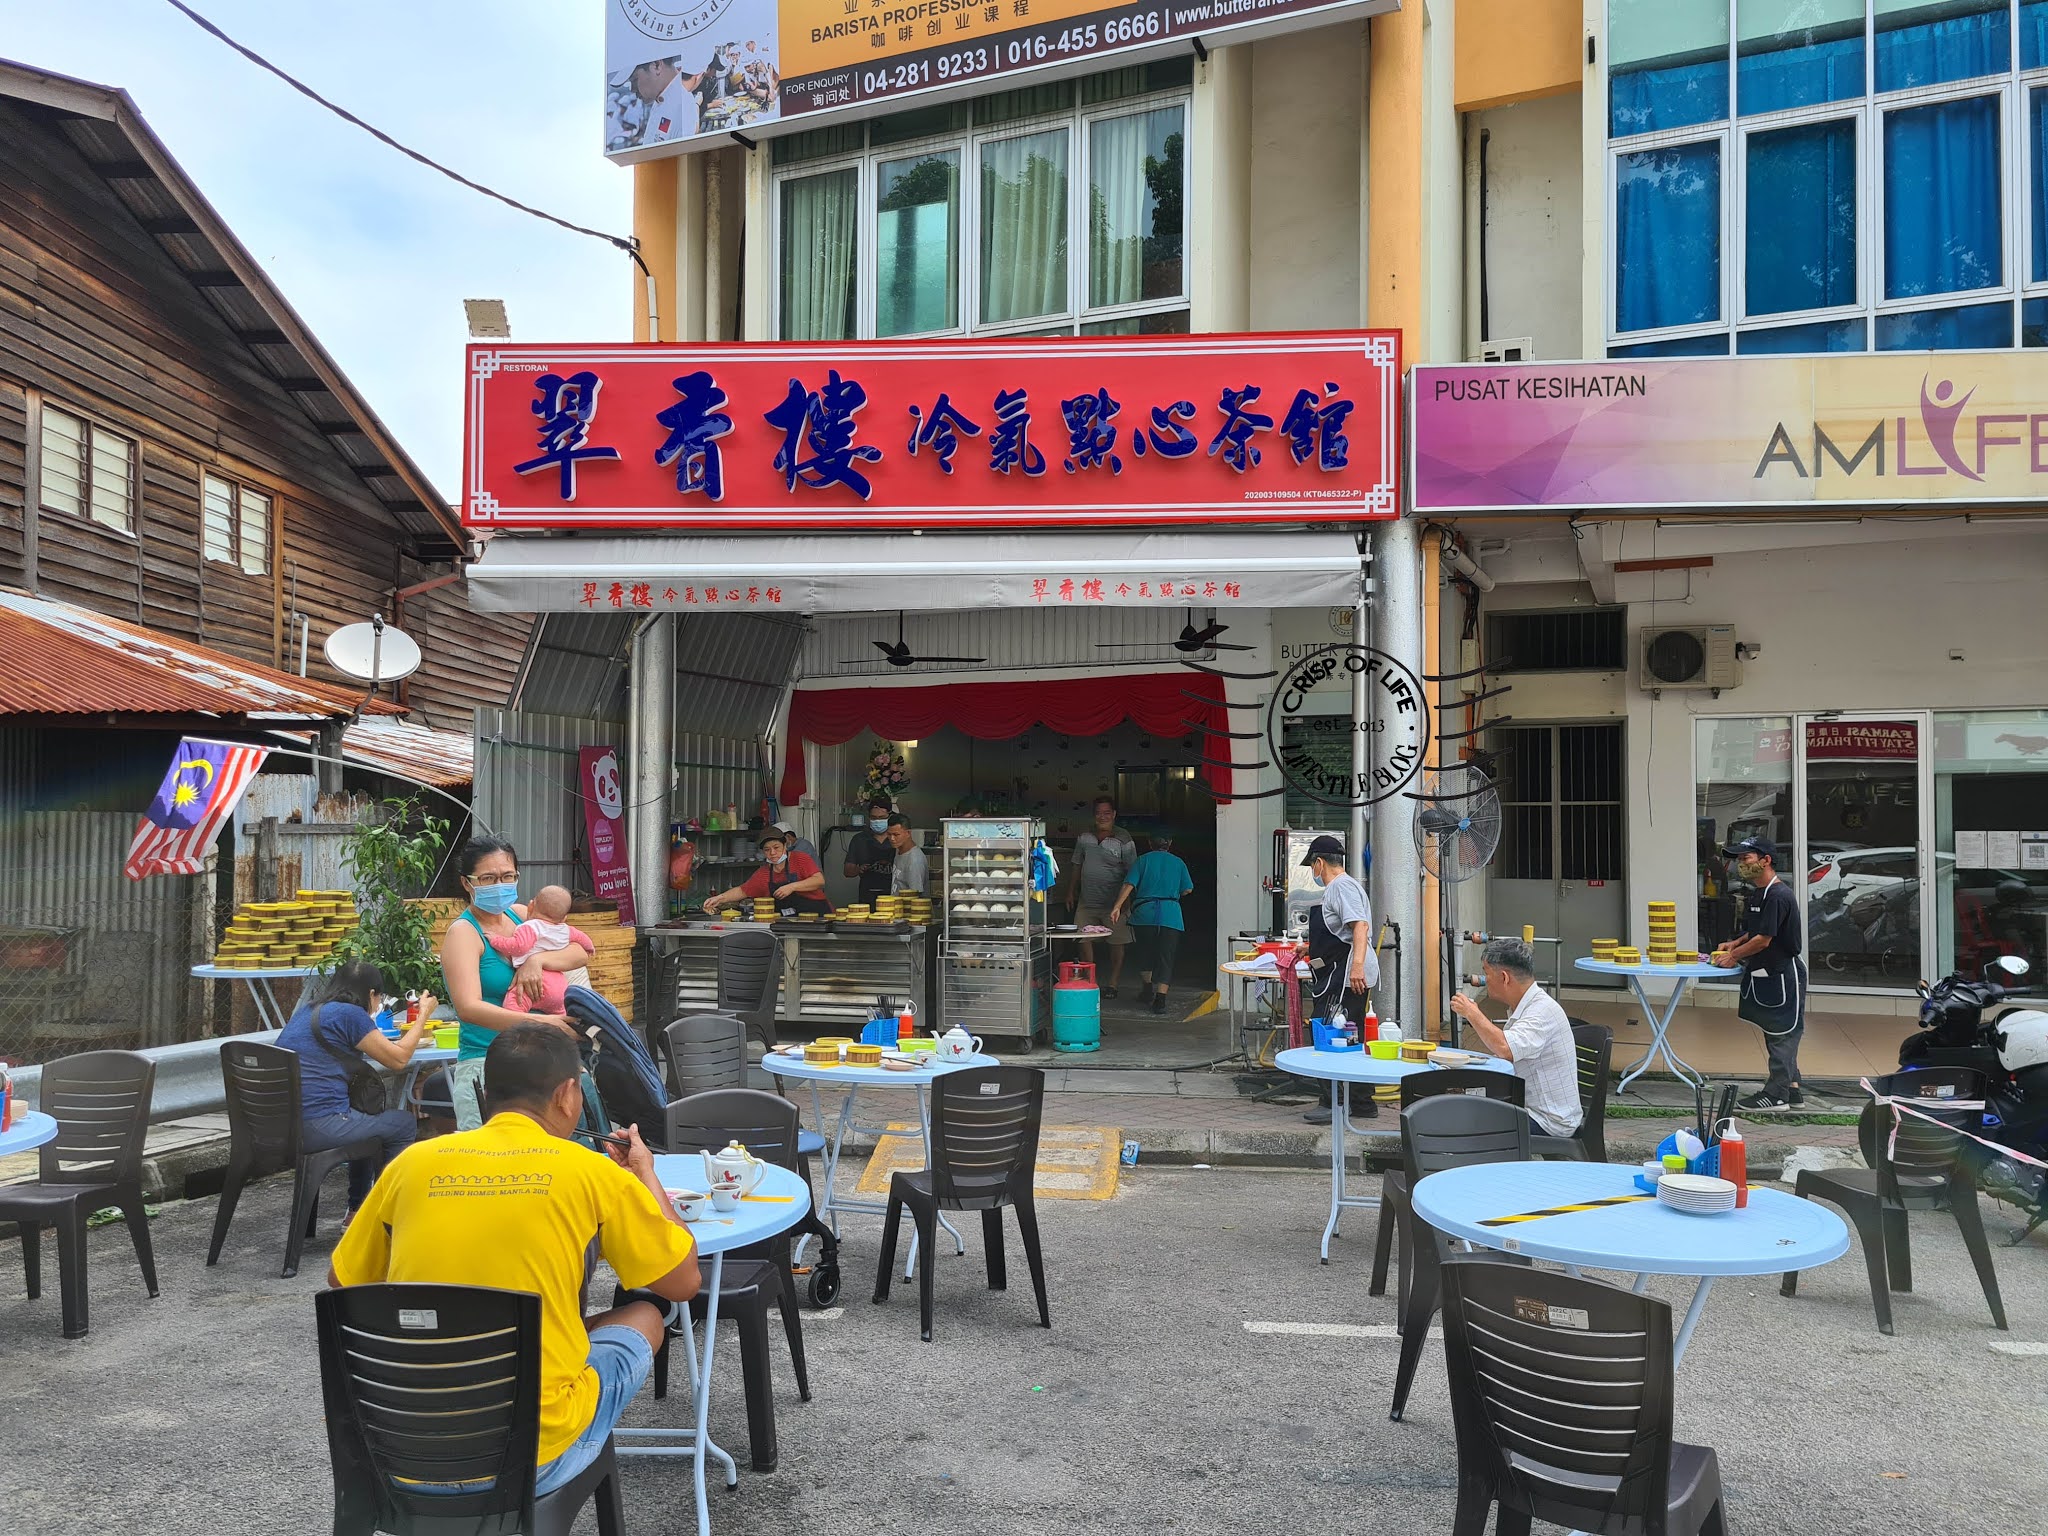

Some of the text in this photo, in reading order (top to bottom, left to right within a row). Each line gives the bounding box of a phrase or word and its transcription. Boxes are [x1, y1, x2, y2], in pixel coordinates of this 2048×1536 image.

[628, 0, 725, 36] Baking Acad
[811, 16, 879, 43] BARISTA
[871, 0, 1030, 48] 咖啡创业课程
[863, 60, 930, 94] 04-281
[937, 48, 988, 79] 9233
[1008, 24, 1098, 64] 016-455
[1104, 11, 1160, 44] 6666
[785, 73, 850, 96] FOR ENQUIRY
[812, 86, 851, 107] 询问处
[503, 364, 549, 372] RESTORAN
[1435, 375, 1646, 402] PUSAT KESIHATAN
[513, 369, 1355, 502] 翠香樓 冷氣點心茶館
[1281, 642, 1338, 659] BUTTER
[599, 878, 615, 894] you
[428, 1189, 465, 1198] BUILDING
